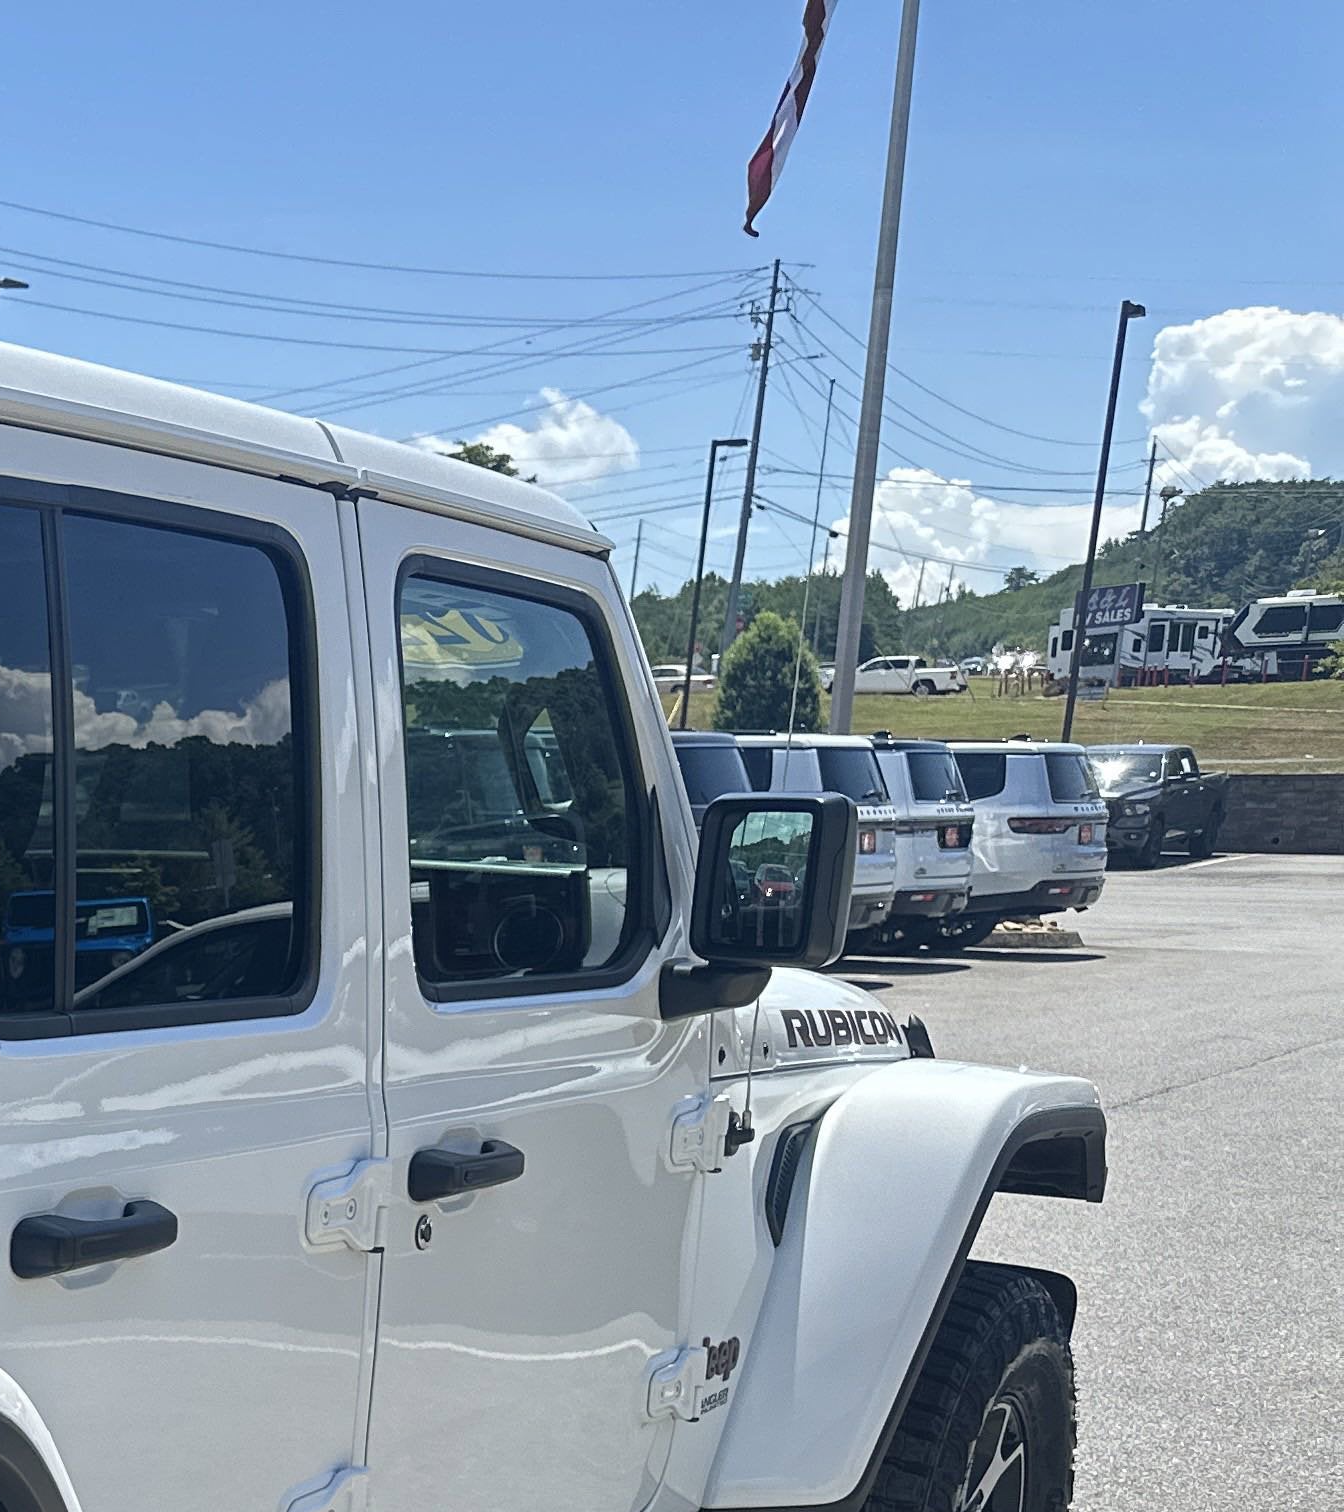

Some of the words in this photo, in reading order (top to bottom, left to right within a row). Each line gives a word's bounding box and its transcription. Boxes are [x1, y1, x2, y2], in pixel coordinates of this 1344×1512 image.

[1094, 608, 1131, 624] SALES
[780, 1009, 903, 1047] RUBICON
[702, 1336, 740, 1381] eep
